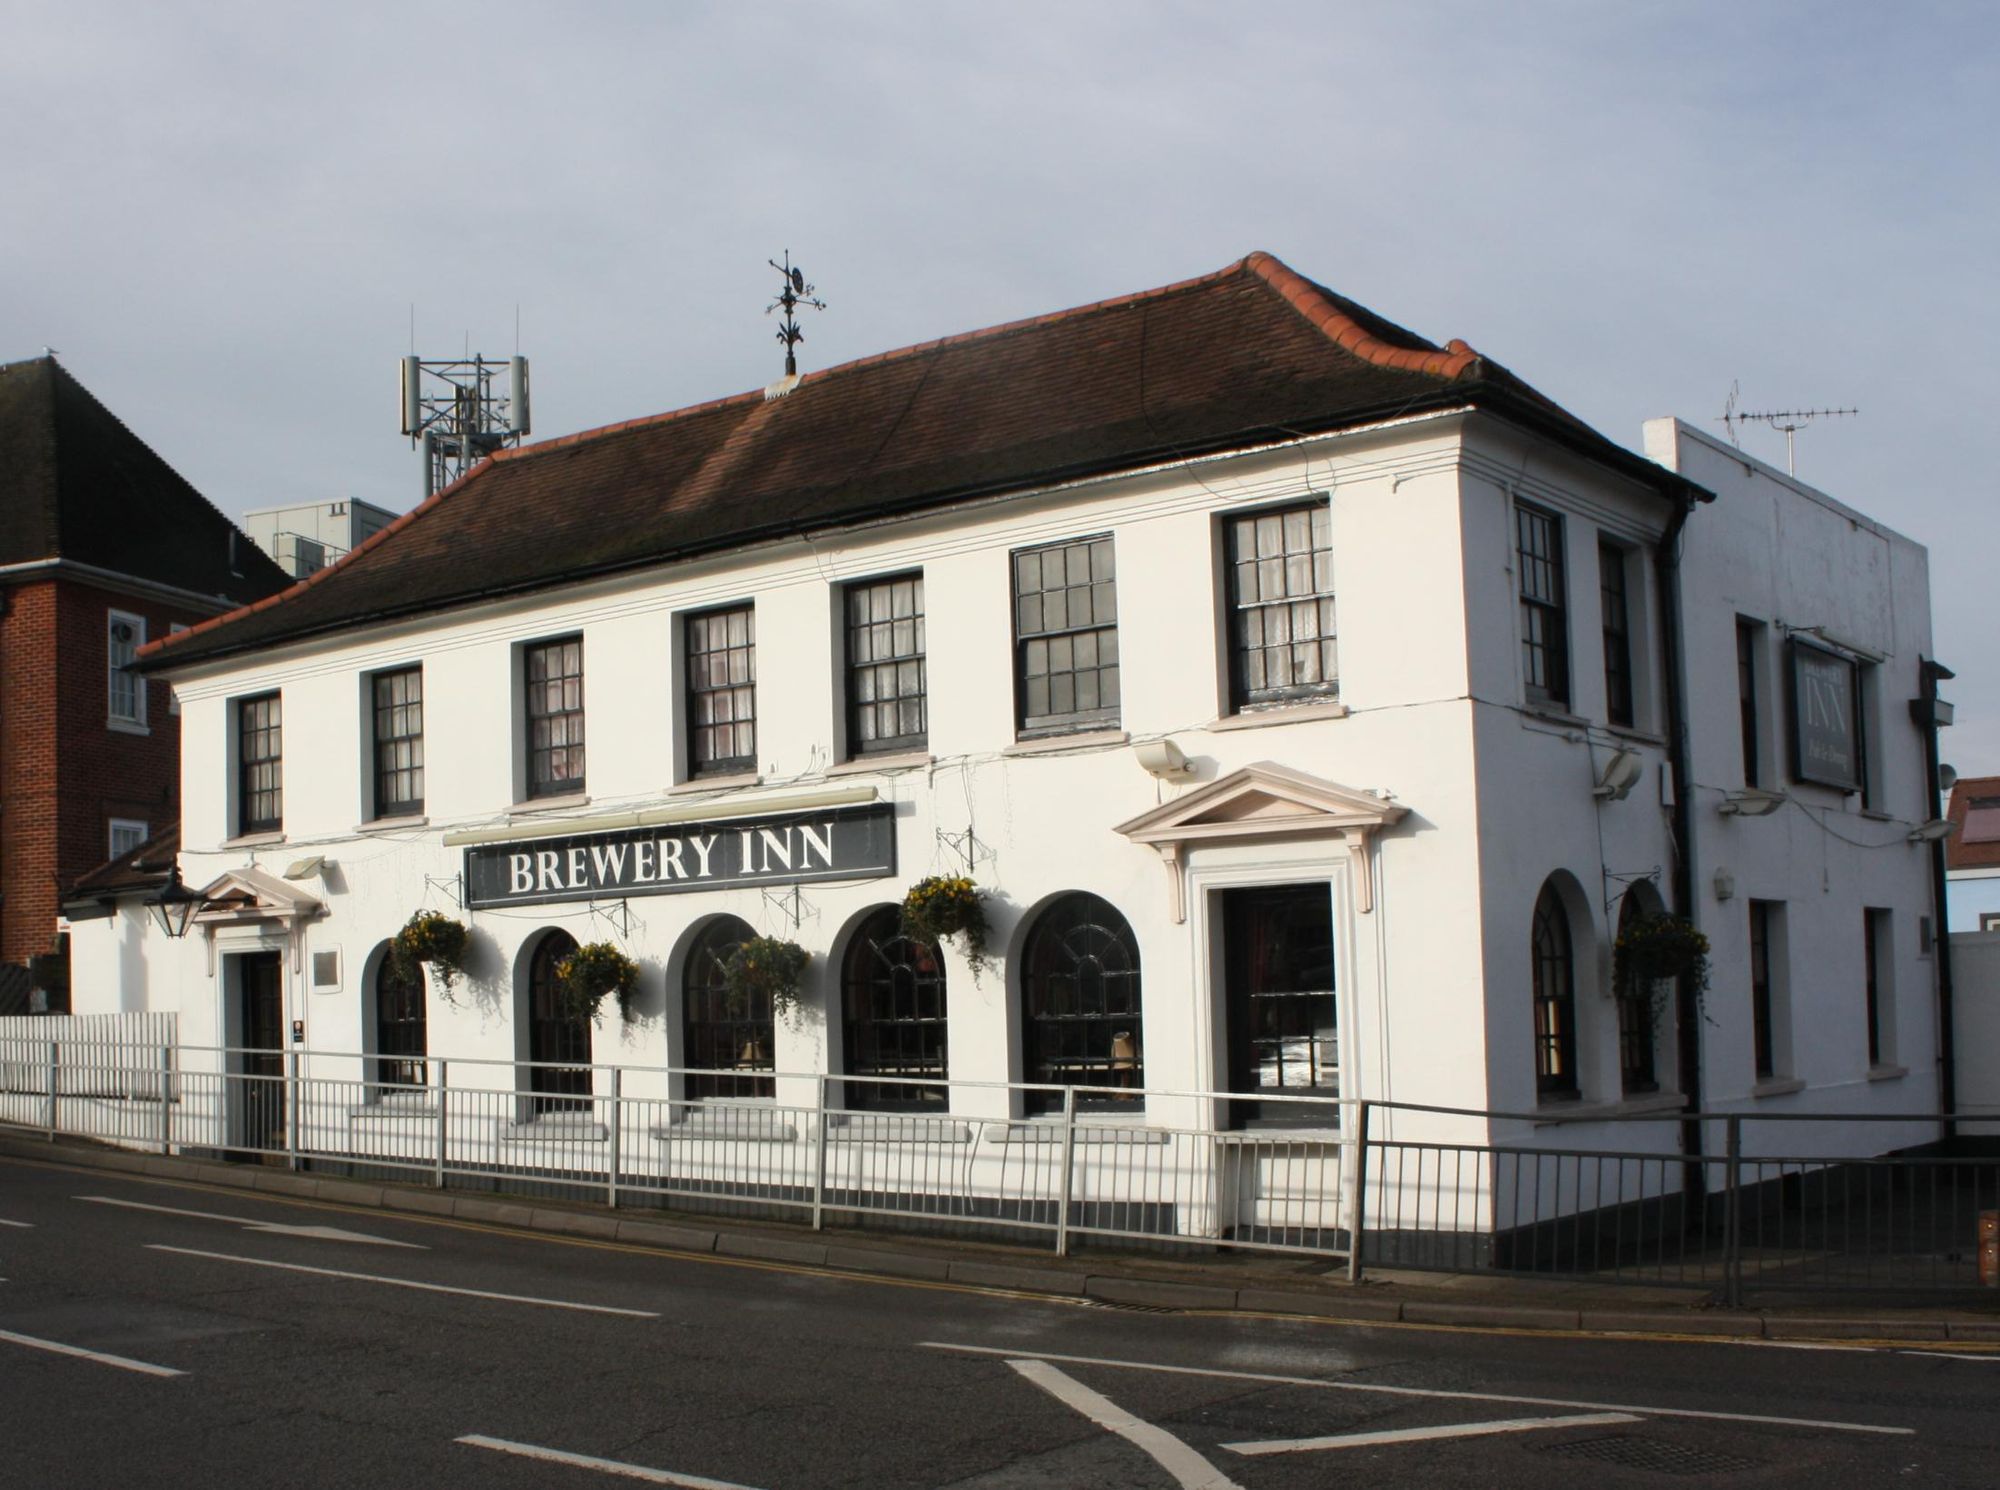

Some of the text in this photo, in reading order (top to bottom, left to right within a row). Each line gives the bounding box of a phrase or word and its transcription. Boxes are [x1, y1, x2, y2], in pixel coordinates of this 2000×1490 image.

[1805, 676, 1846, 733] INN
[509, 823, 834, 894] BREWERY INN
